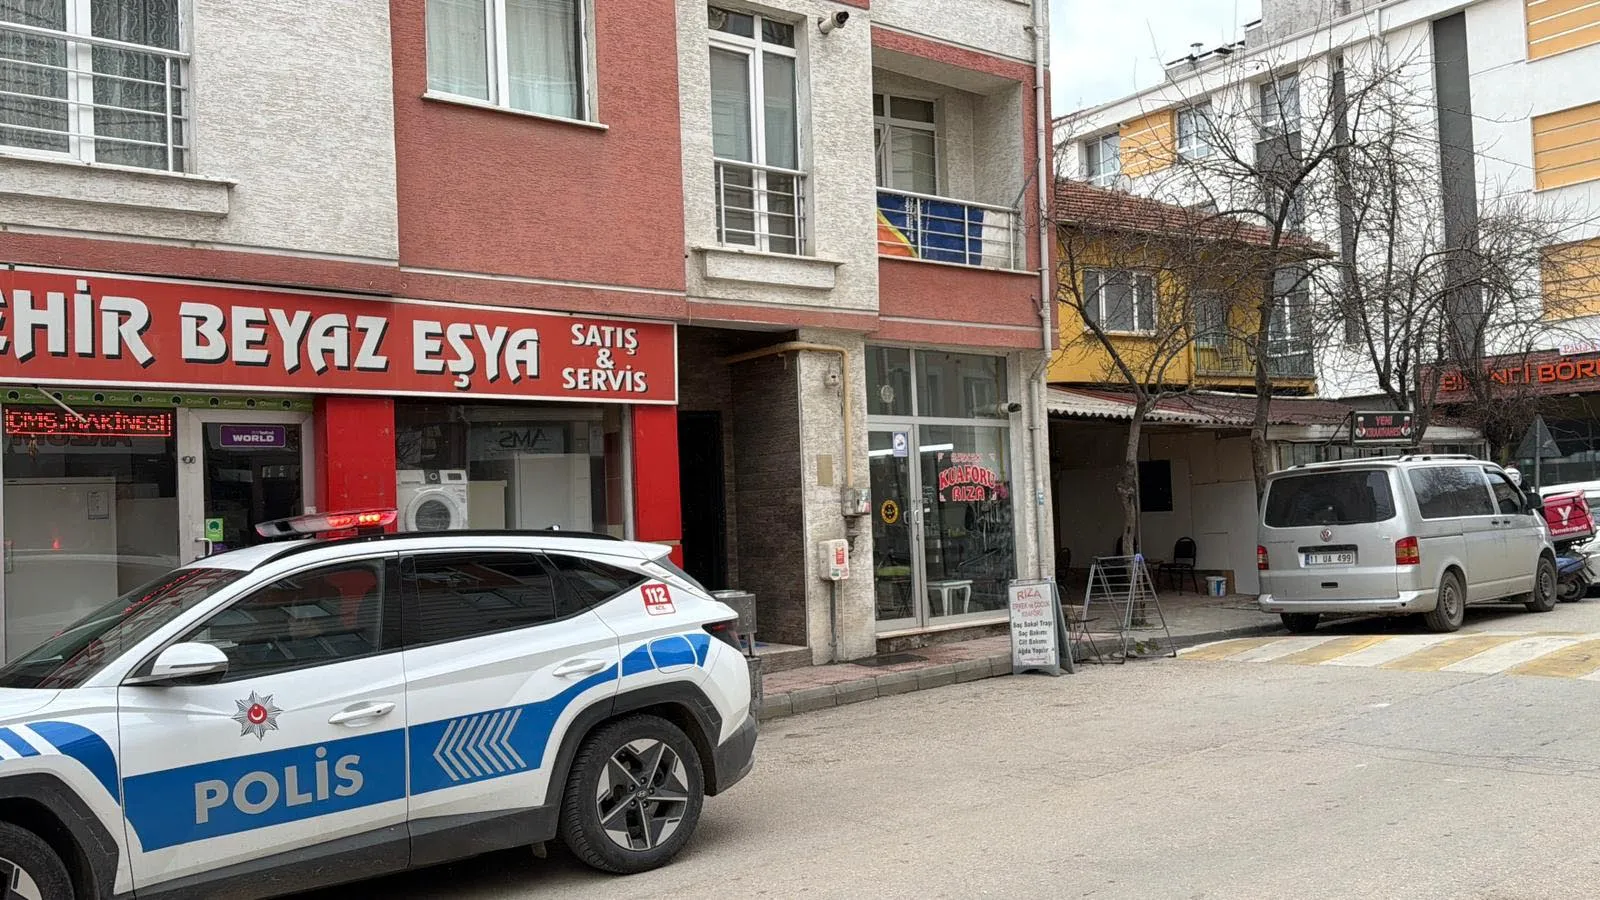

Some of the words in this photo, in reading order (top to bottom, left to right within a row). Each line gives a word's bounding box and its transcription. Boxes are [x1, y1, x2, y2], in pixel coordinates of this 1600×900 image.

[0, 279, 155, 369] HİR
[179, 301, 389, 376] BEYAZ
[413, 319, 540, 390] EŞYA
[571, 323, 638, 356] SATIŞ
[596, 348, 615, 370] &
[562, 365, 648, 394] SERVİS
[232, 434, 275, 442] WORLD
[1310, 555, 1318, 563] 11
[1323, 554, 1332, 563] UA
[1337, 553, 1352, 562] 499
[645, 586, 668, 604] 112
[195, 746, 364, 825] POLİS
